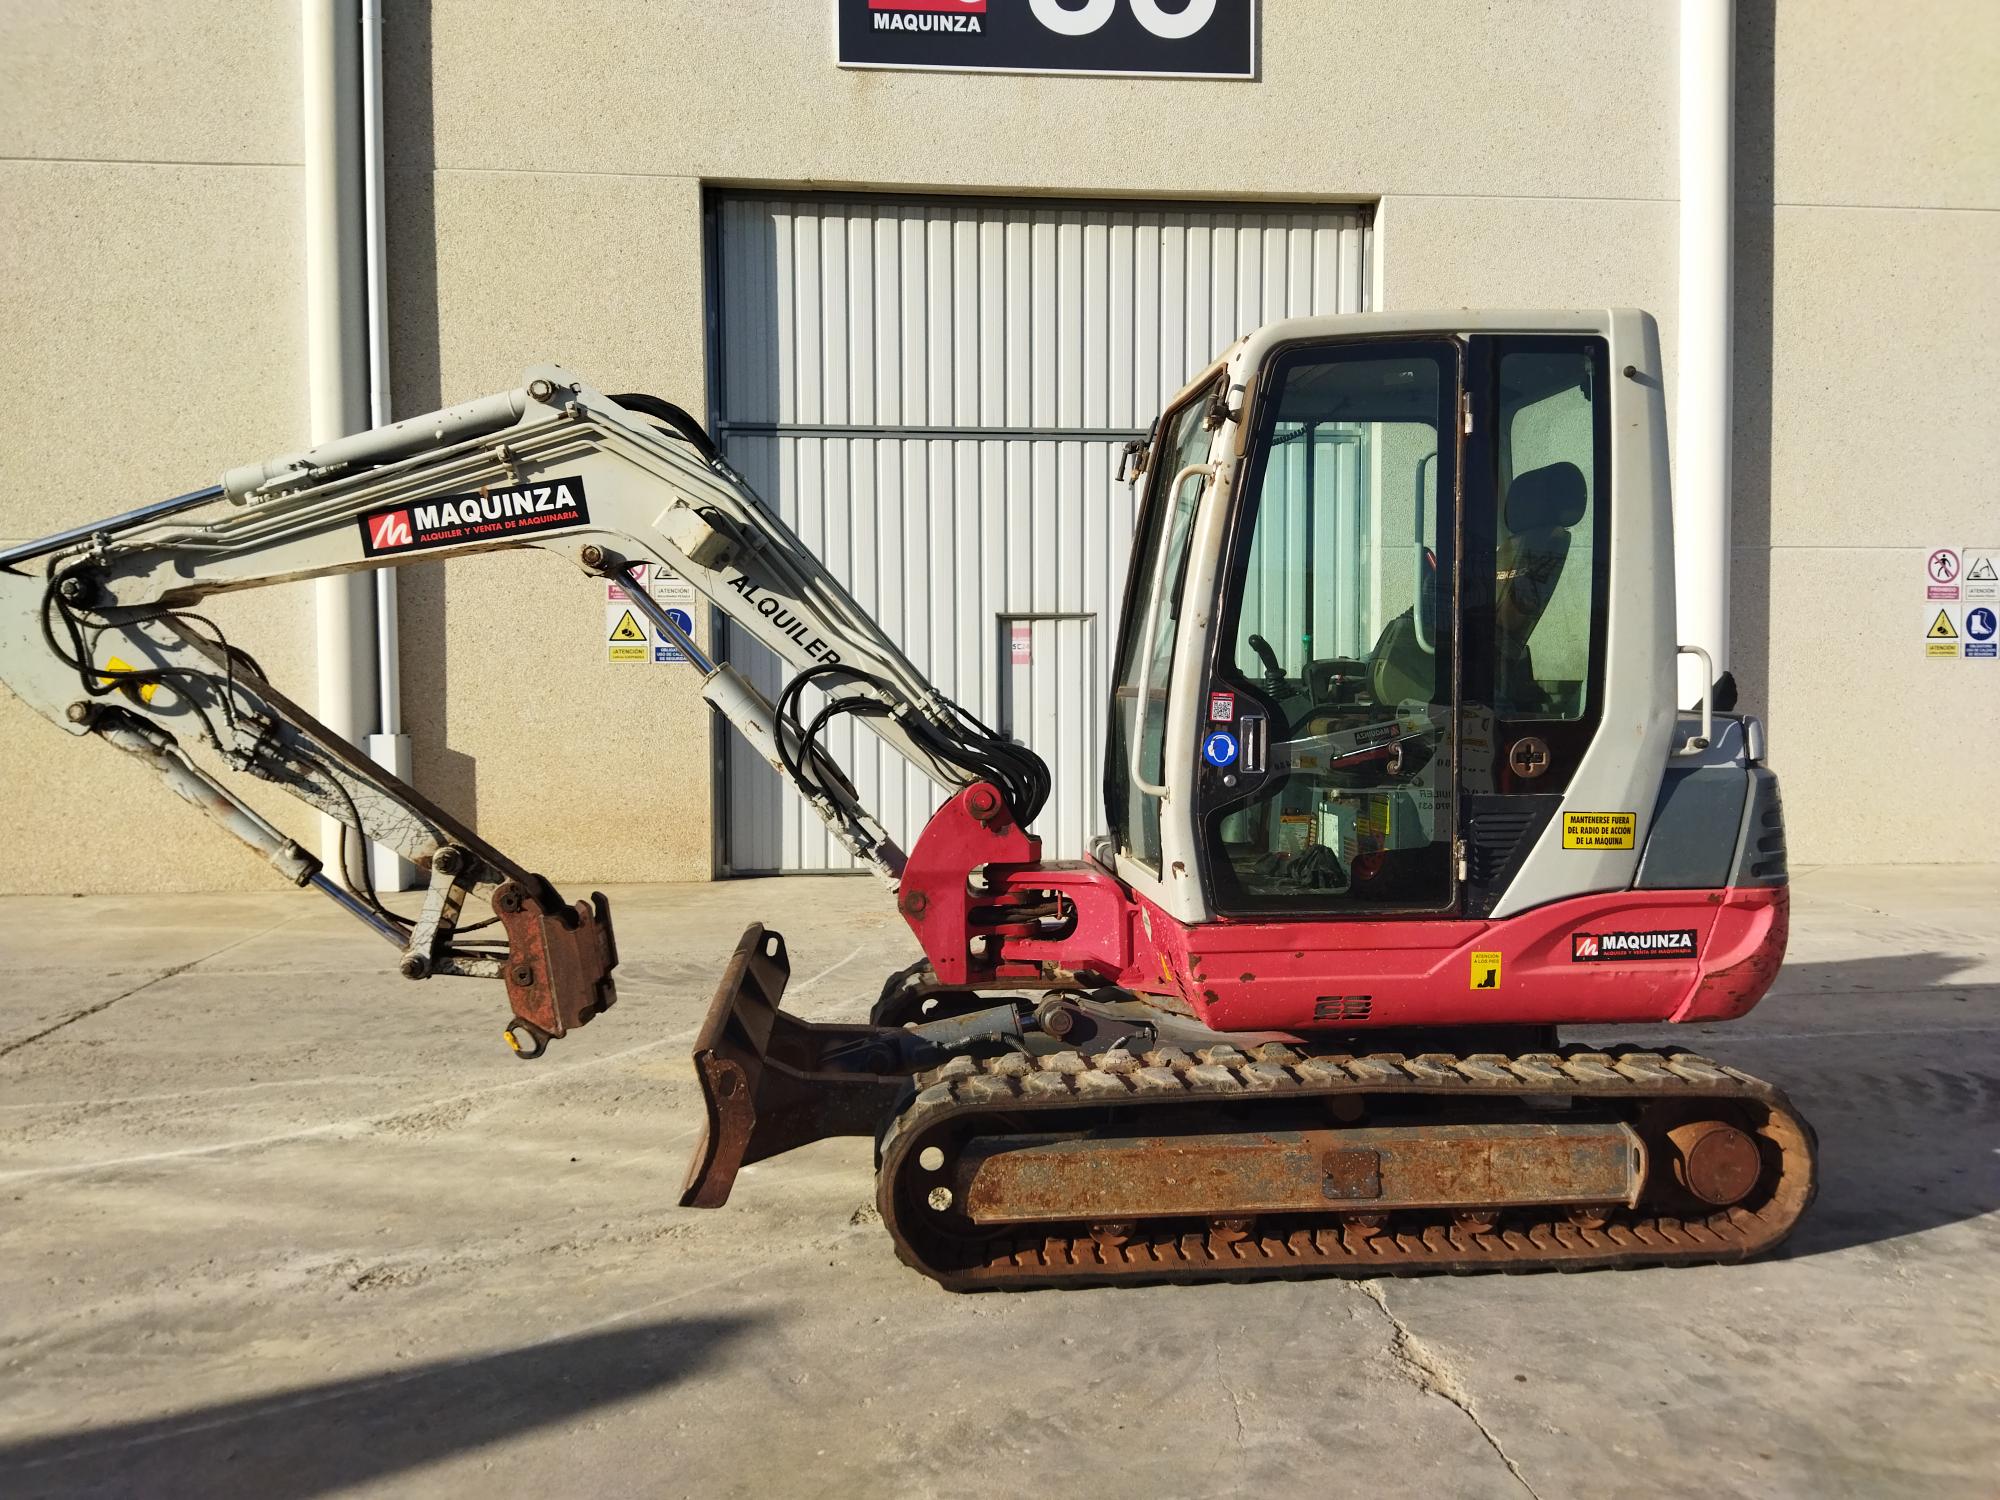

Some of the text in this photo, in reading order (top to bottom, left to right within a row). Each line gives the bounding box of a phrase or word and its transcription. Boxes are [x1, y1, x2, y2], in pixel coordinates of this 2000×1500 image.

[873, 12, 982, 33] MAQUINZA
[414, 485, 576, 530] MAQUINZA
[420, 510, 579, 543] ALQUILER Y VENTA DE MAQUINARIA
[727, 575, 841, 665] ALQUILER
[1570, 816, 1630, 825] MANTENERSE FUERA
[1568, 826, 1579, 834] DEL
[1580, 826, 1600, 835] RADIO
[1601, 826, 1609, 835] DE
[1576, 837, 1584, 845] DE
[1585, 837, 1593, 845] LA
[1602, 933, 1692, 950] MAQUINZA
